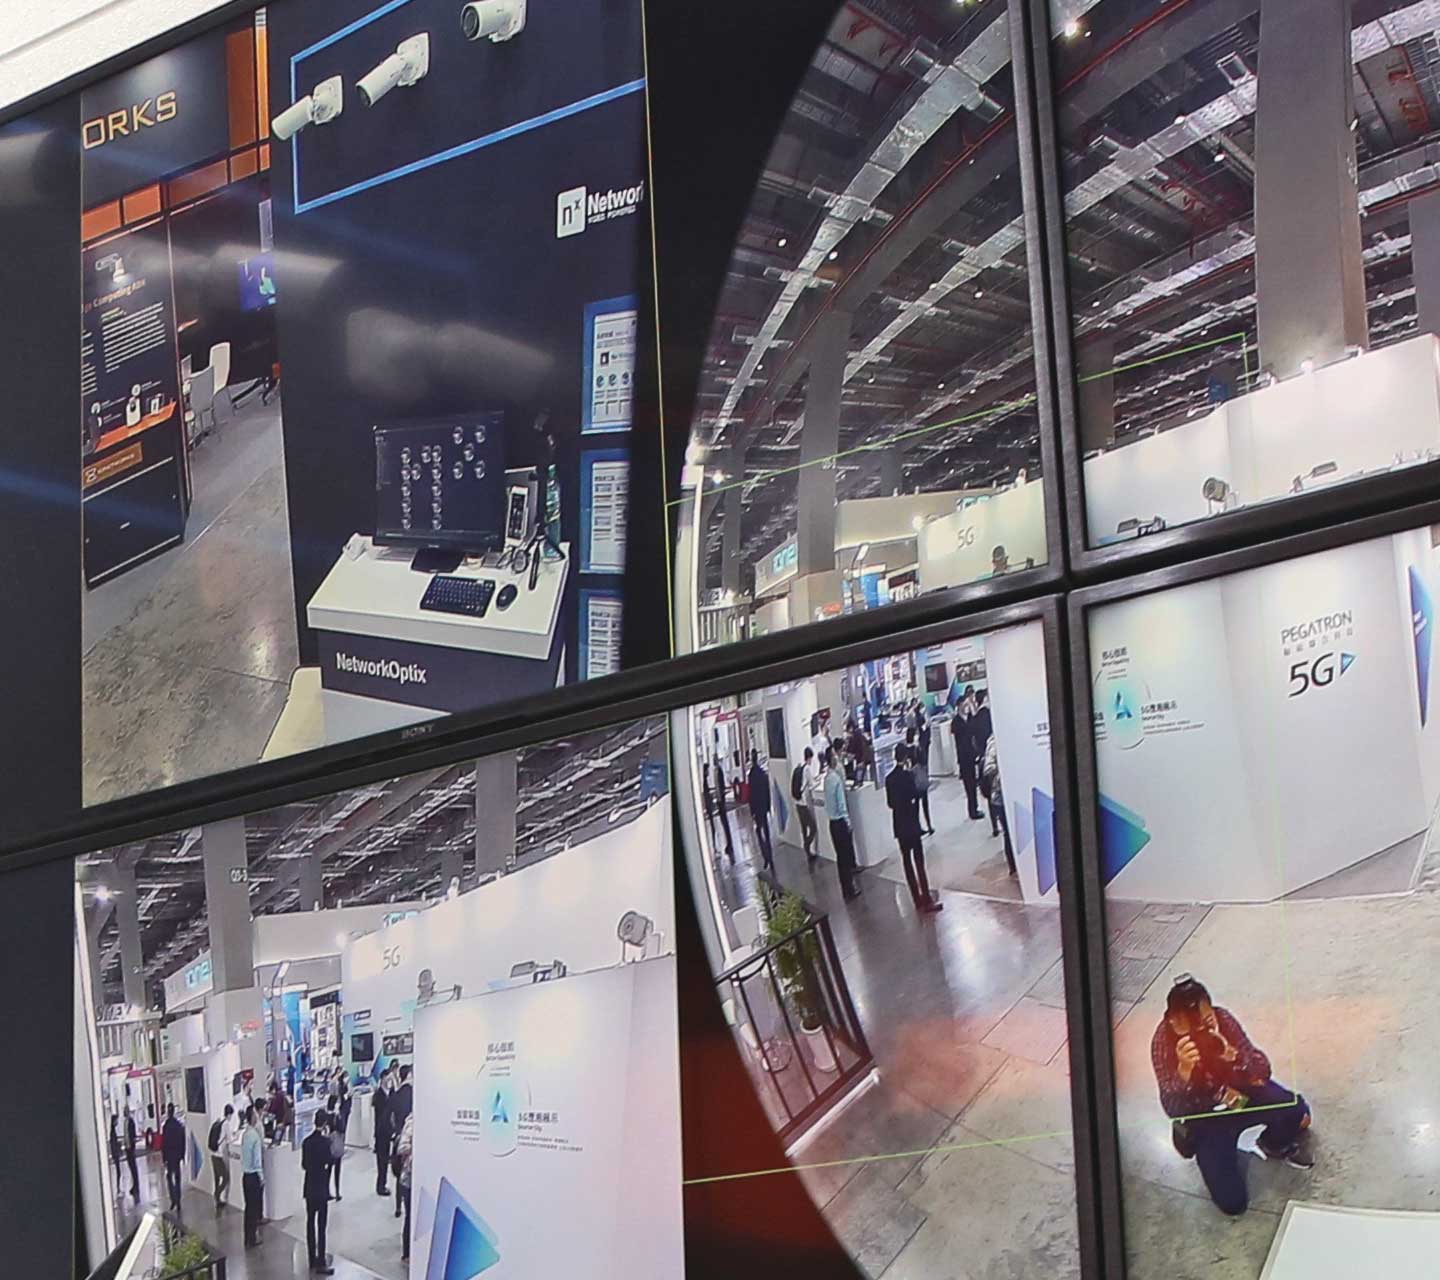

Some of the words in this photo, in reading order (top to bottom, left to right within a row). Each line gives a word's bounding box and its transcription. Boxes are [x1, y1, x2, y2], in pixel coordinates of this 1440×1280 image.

[82, 90, 178, 151] ORKS
[1281, 609, 1353, 645] PEGATRON
[336, 651, 427, 685] NetworkOptix
[1287, 652, 1335, 699] 5G
